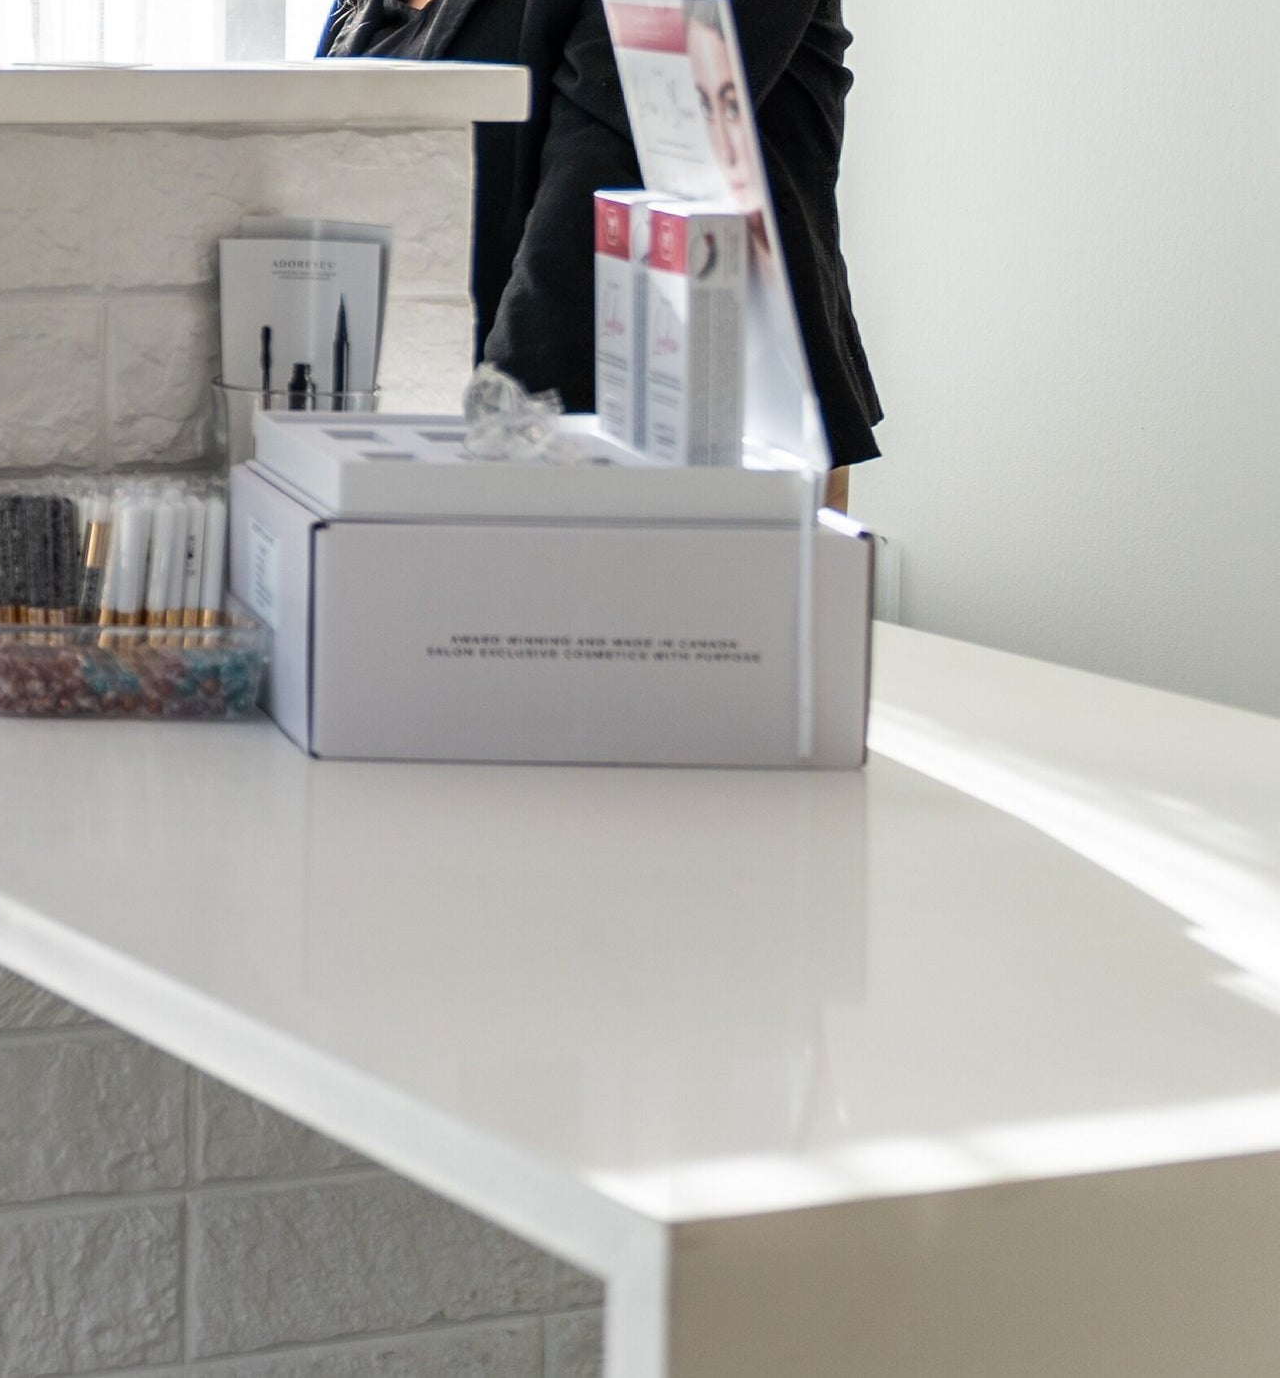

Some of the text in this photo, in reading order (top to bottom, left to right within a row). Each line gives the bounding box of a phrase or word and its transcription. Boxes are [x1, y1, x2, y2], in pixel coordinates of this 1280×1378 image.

[450, 635, 738, 649] AWARD WINNING AND MADE IN CANADA
[426, 647, 761, 662] SALON EXCLUSIVE COSMETICS WITH PURPOSE
